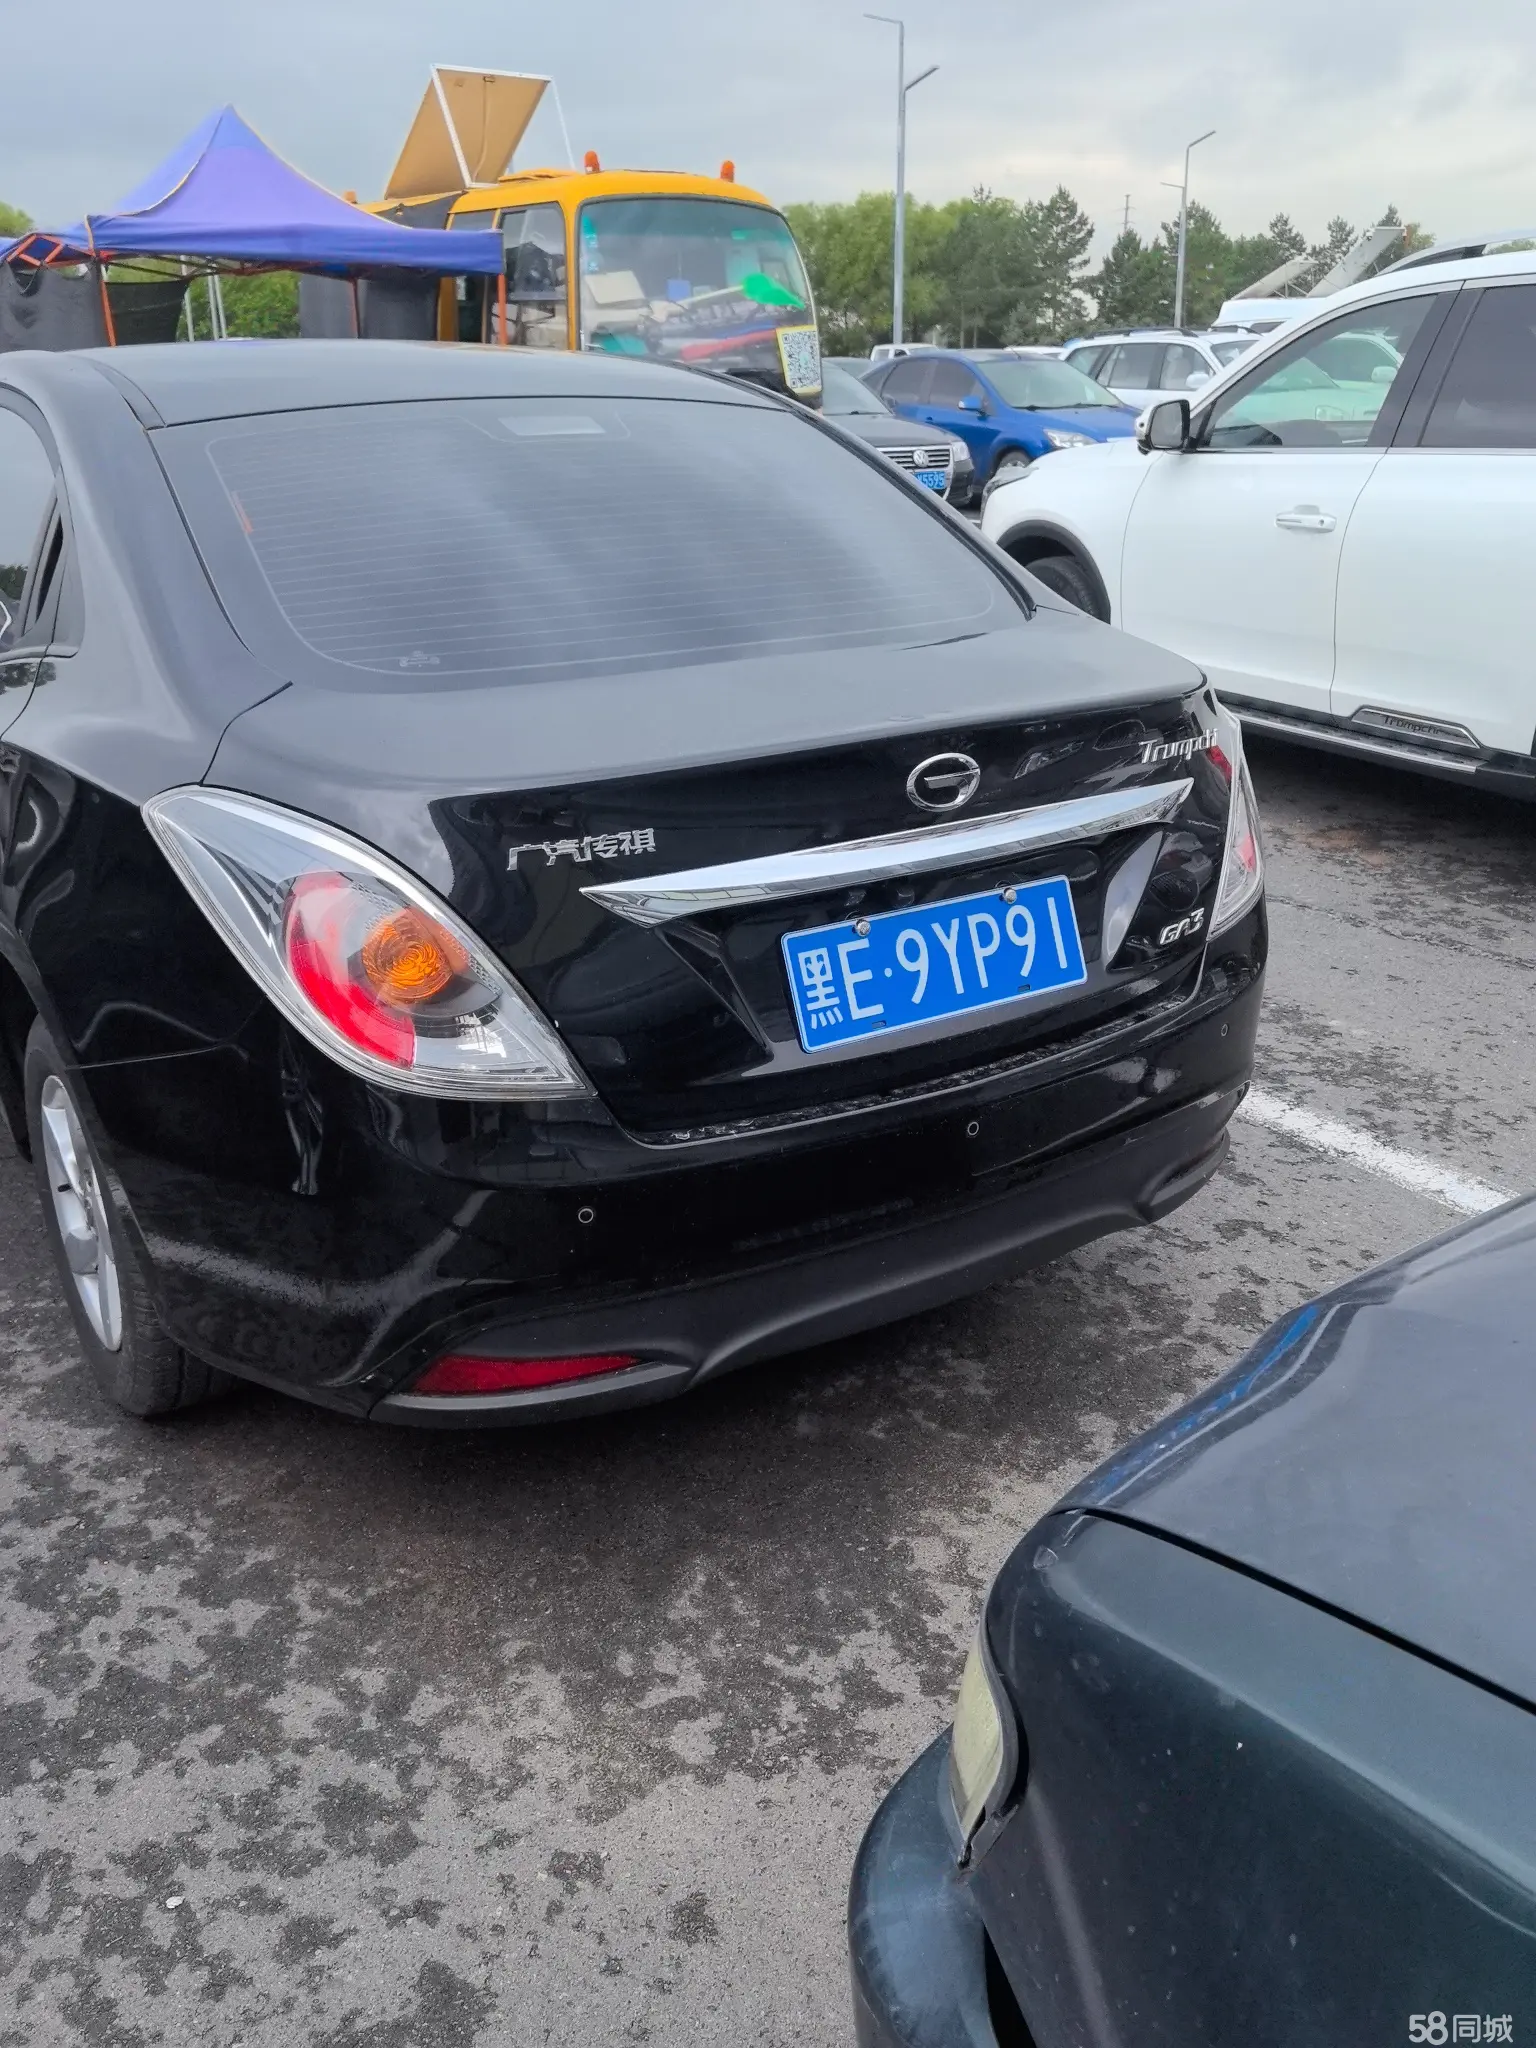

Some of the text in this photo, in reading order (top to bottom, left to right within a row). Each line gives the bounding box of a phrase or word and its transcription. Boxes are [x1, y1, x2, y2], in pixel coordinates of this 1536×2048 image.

[1138, 728, 1218, 764] Trumpchi
[507, 828, 656, 871] 广汽传祺
[797, 896, 1068, 1030] 黑E·9YP91
